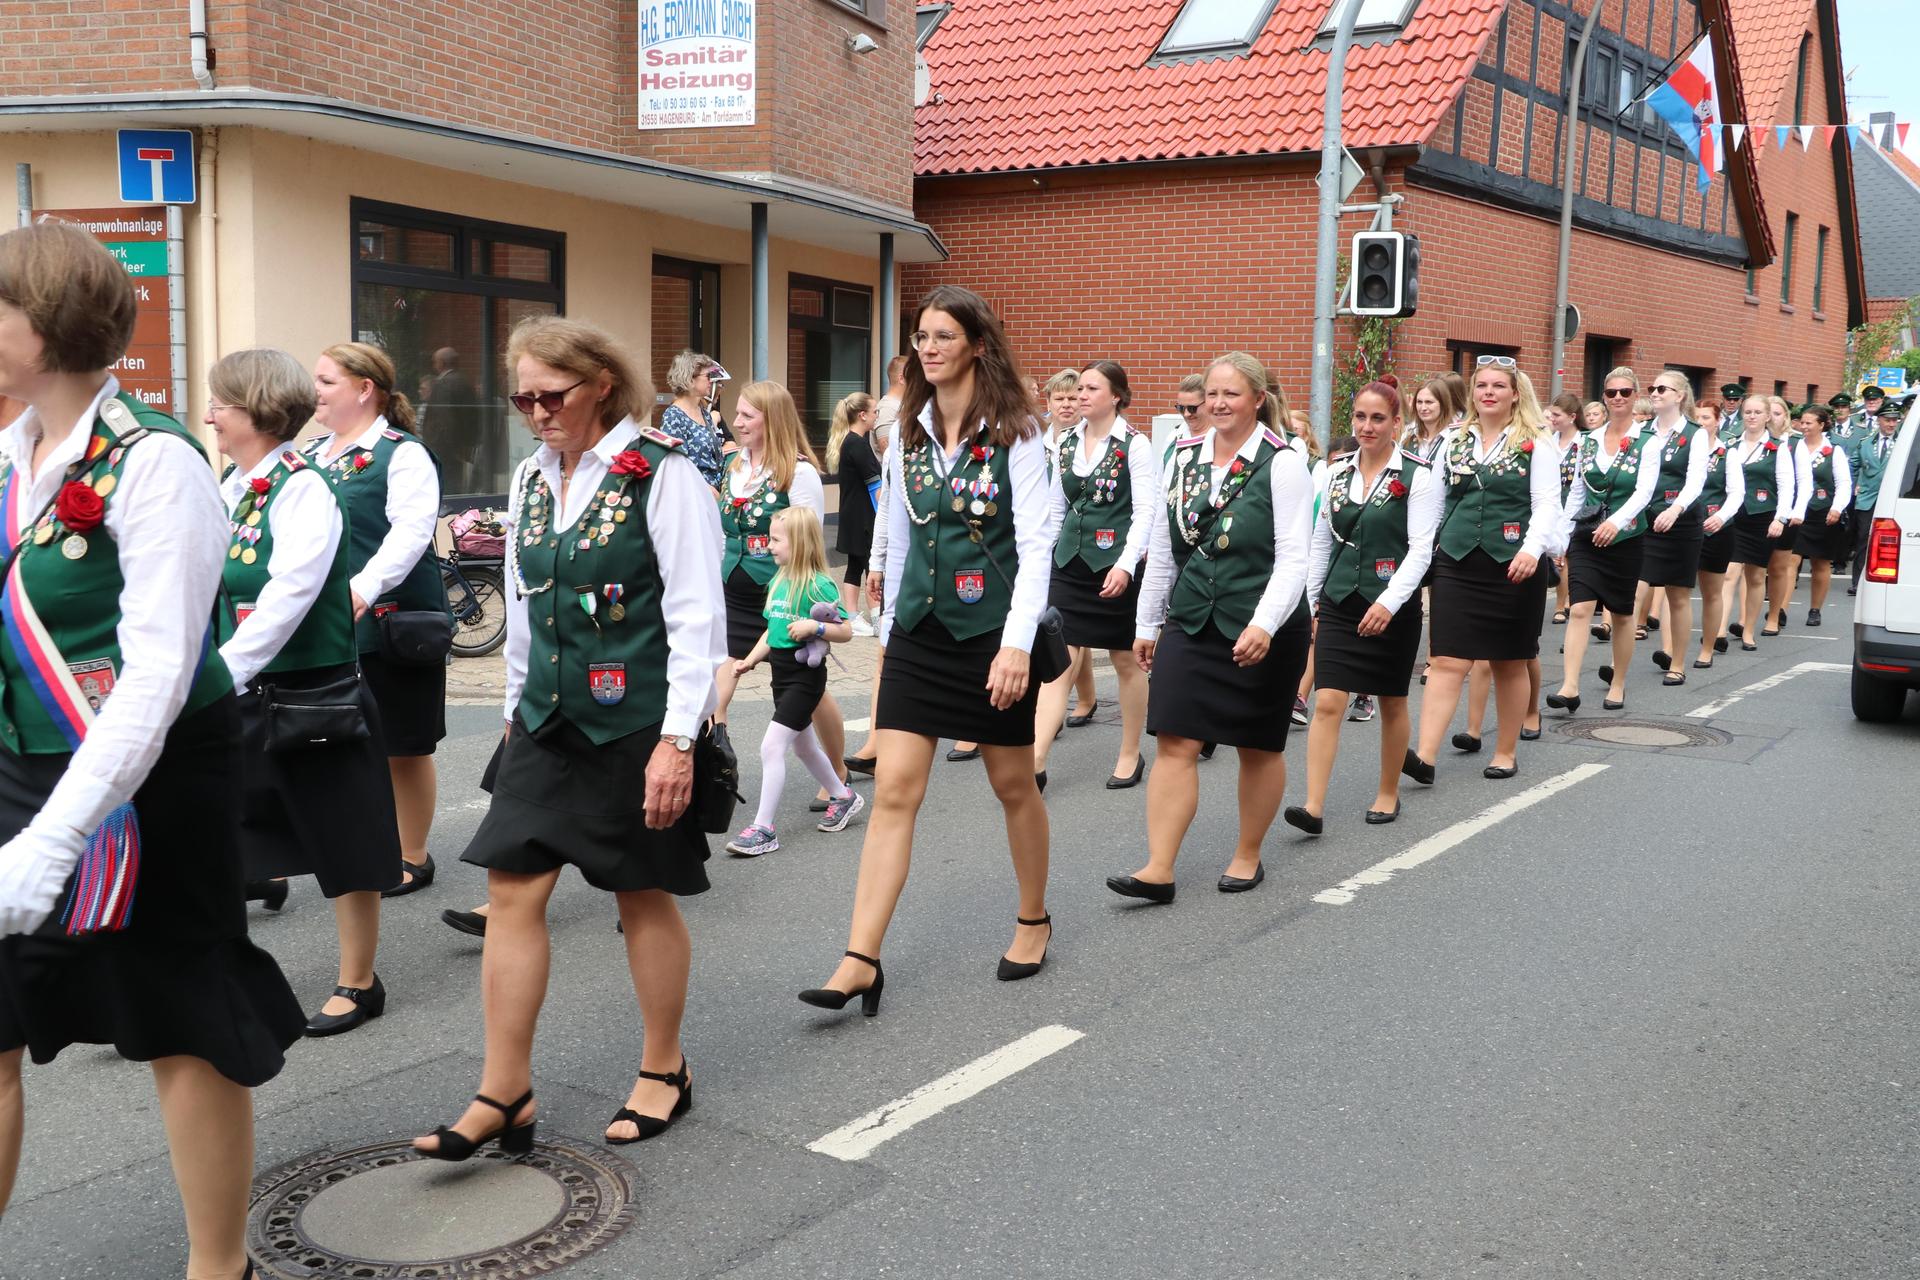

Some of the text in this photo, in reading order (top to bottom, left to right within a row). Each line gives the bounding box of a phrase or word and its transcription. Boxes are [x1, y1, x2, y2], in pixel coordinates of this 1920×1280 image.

[641, 0, 752, 47] H.G. ERDMANN GMBH
[645, 45, 748, 67] Sanitär
[640, 71, 753, 91] Heizung
[714, 96, 725, 108] Fax
[659, 111, 696, 125] HAGENBURG
[701, 110, 712, 123] Am
[135, 387, 167, 404] Kanal
